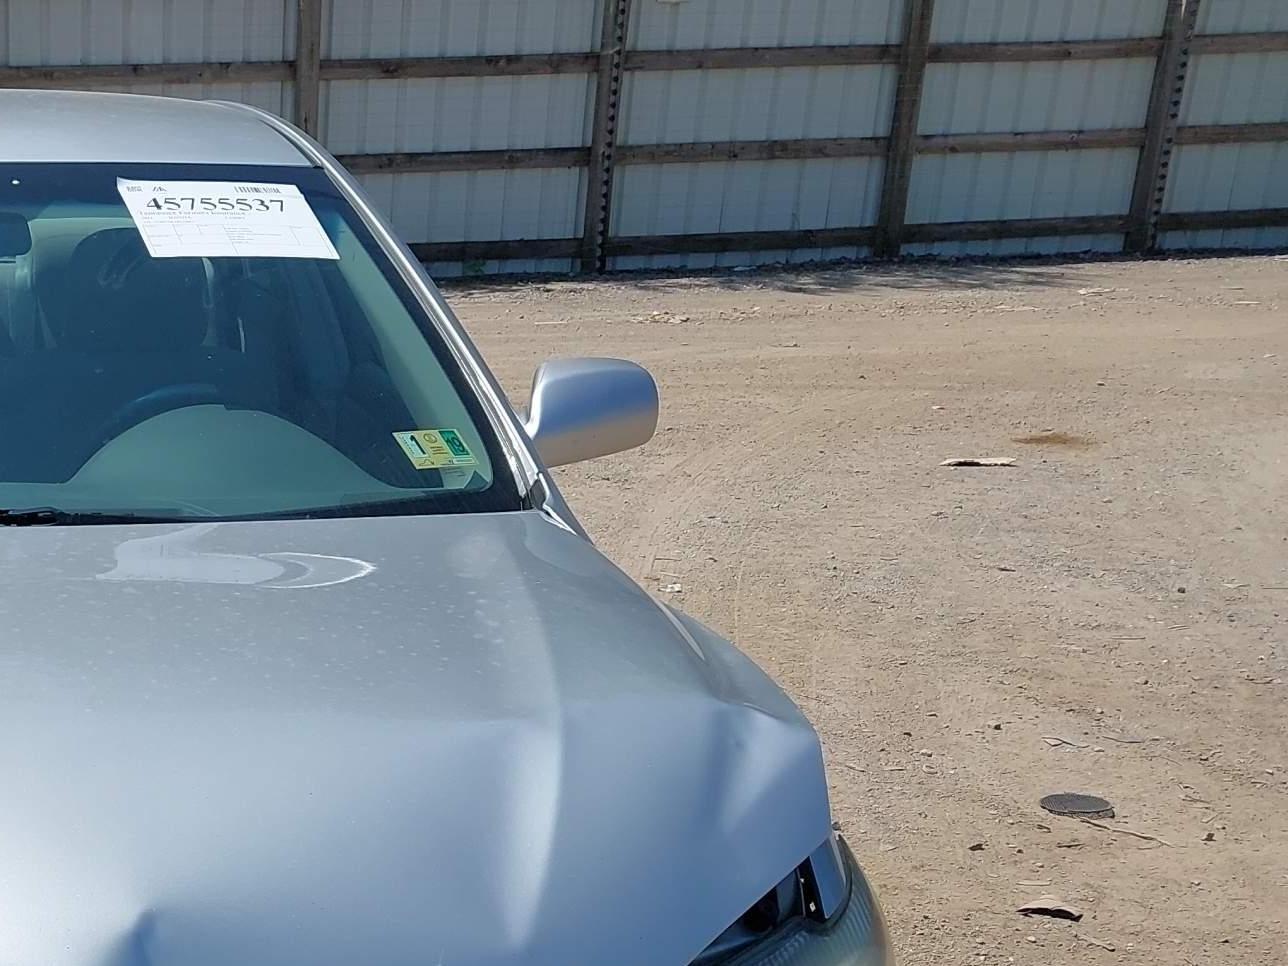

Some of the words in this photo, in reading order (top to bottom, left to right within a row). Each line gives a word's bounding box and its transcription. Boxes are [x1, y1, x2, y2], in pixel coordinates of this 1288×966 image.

[146, 197, 284, 213] 45755537
[409, 434, 426, 455] 1
[445, 437, 467, 455] 19
